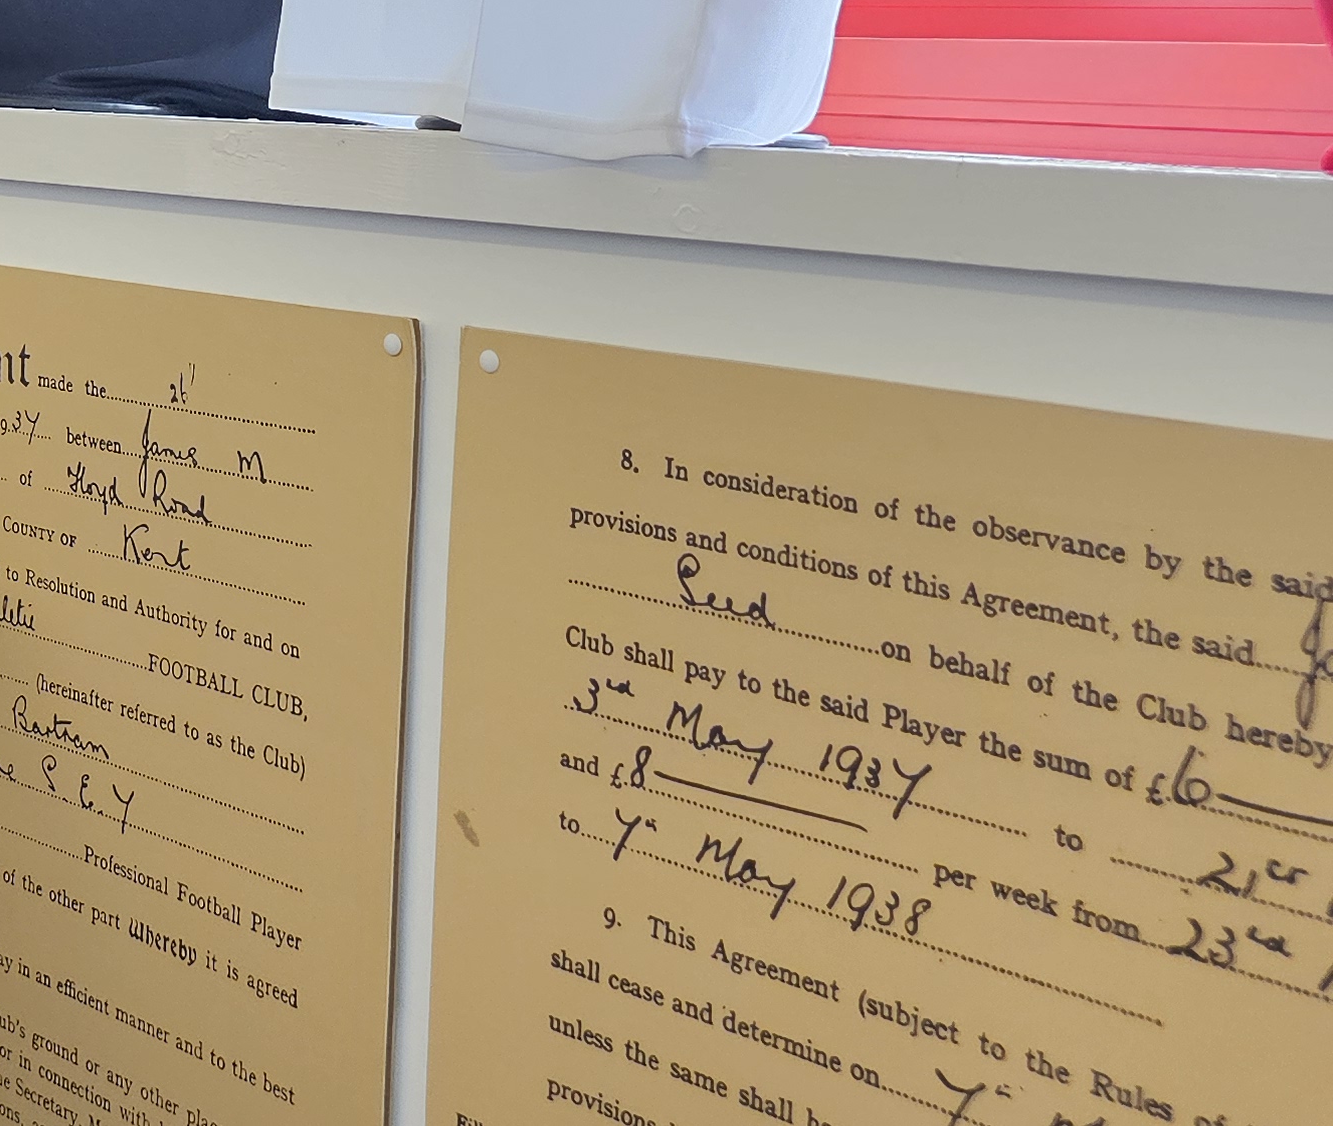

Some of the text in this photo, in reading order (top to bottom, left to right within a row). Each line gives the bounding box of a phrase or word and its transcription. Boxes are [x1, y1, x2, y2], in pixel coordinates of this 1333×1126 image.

[37, 374, 74, 393] made
[84, 380, 107, 399] the
[19, 470, 33, 487] of
[66, 426, 122, 455] between
[60, 532, 77, 548] OF
[620, 448, 640, 473] 8.
[664, 456, 689, 482] In
[702, 469, 859, 514] consideration
[874, 498, 900, 521] of
[915, 504, 956, 533] the
[972, 516, 1126, 564] observance
[1144, 544, 1183, 579] by
[1202, 555, 1253, 588] the
[6, 566, 19, 582] to
[25, 568, 96, 604] Resolution
[101, 594, 128, 612] and
[134, 599, 208, 638] Authority
[215, 619, 236, 641] for
[243, 633, 273, 652] and
[281, 642, 300, 659] on
[569, 506, 1255, 668] provisions and conditions of this Agreement, the said
[36, 672, 114, 714] (hereinafter
[120, 703, 176, 734] referred
[184, 721, 199, 740] to
[206, 732, 223, 749] as
[230, 735, 255, 759] the
[263, 744, 306, 782] Club)
[148, 653, 244, 699] FOOTBALL
[252, 684, 308, 722] CLUB,
[565, 625, 615, 657] Club
[624, 641, 675, 674] shall
[684, 660, 727, 690] pay
[738, 669, 762, 694] to
[772, 677, 811, 708] the
[820, 693, 870, 724] said
[882, 702, 967, 748] Player
[979, 730, 1022, 763] the
[1033, 748, 1092, 781] sum
[1105, 765, 1135, 792] of
[881, 641, 912, 664] on
[929, 643, 1011, 687] behalf
[1028, 673, 1056, 697] of
[1072, 680, 1118, 713] the
[1136, 692, 1208, 732] Club
[1225, 713, 1333, 769] hereby
[560, 752, 600, 777] and
[933, 862, 977, 892] per
[991, 879, 1059, 917] week
[1071, 898, 1140, 941] from
[1054, 824, 1084, 853] to
